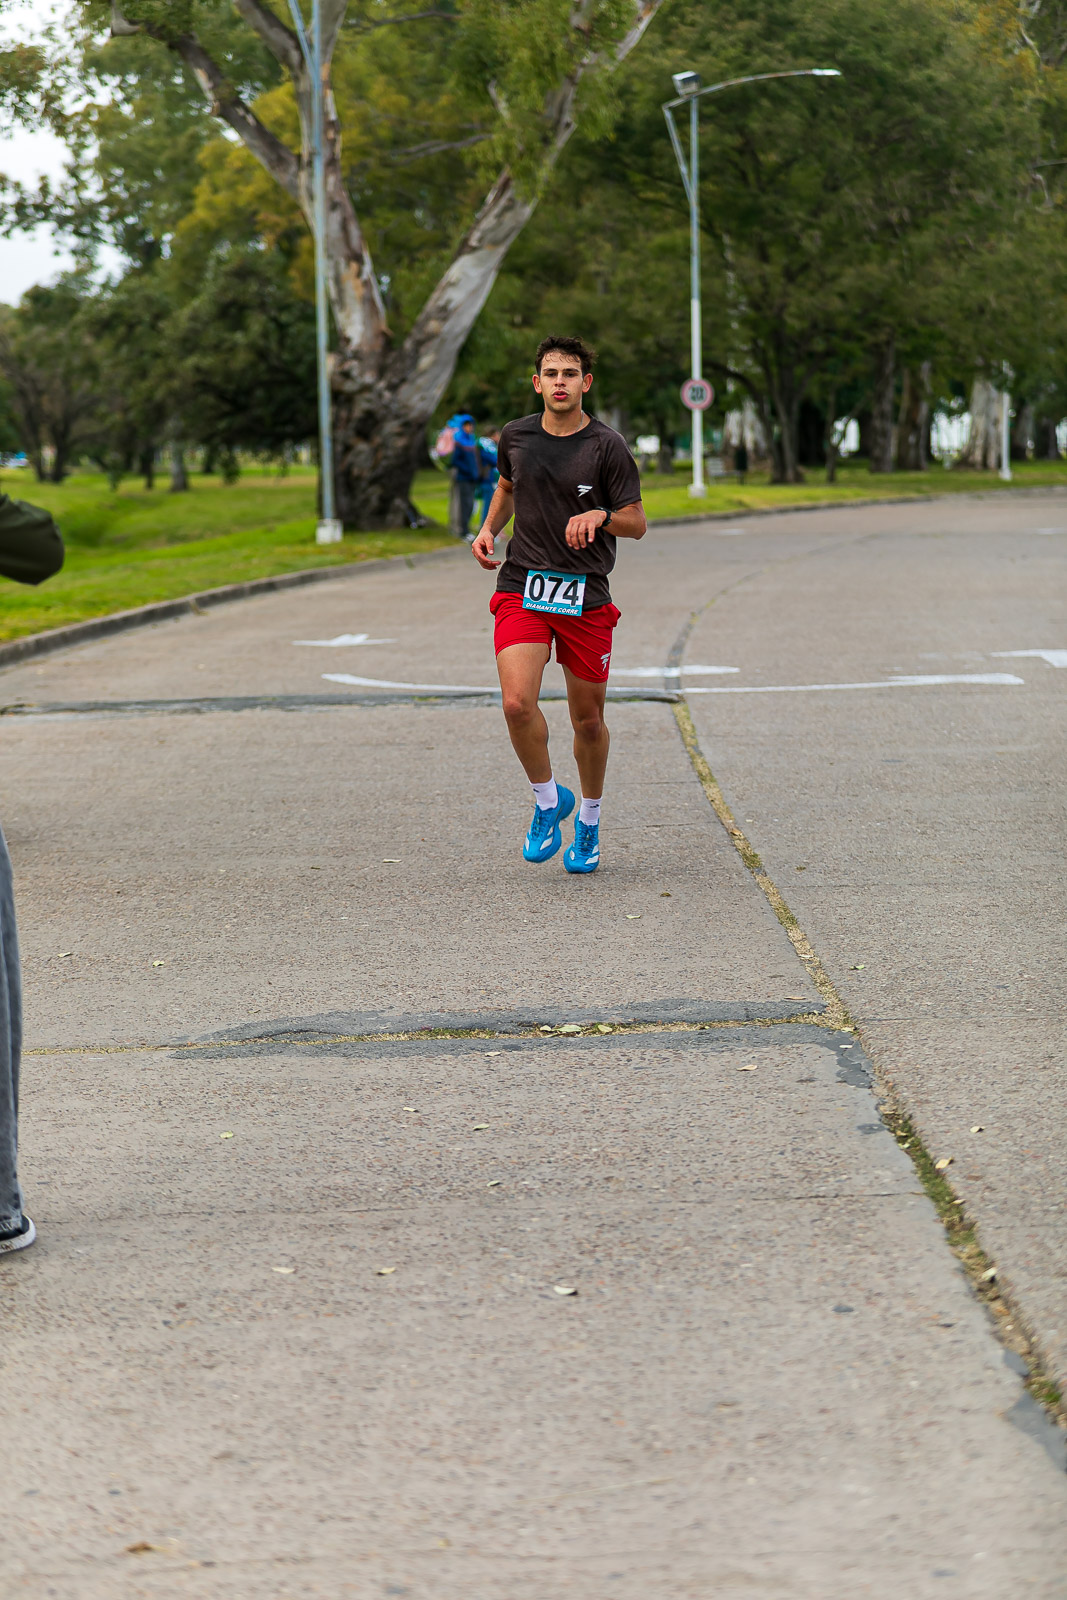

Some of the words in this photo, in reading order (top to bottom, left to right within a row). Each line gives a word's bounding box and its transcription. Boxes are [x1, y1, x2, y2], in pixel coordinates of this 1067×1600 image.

[529, 573, 579, 607] 074
[526, 602, 557, 612] DIAMANTE
[557, 607, 579, 615] CORRE
